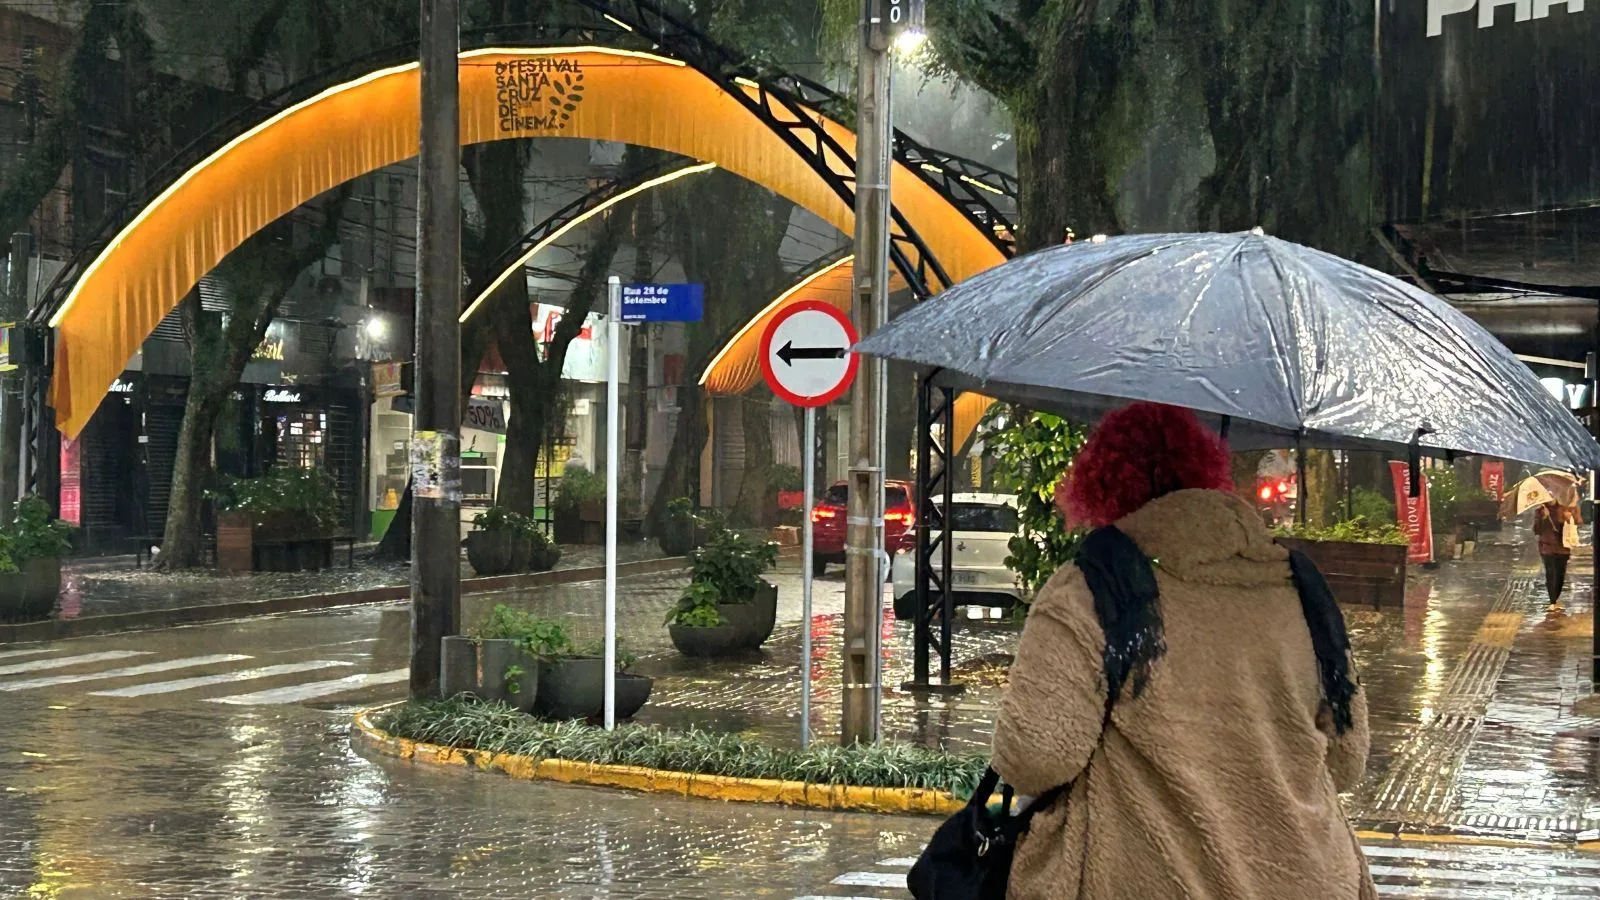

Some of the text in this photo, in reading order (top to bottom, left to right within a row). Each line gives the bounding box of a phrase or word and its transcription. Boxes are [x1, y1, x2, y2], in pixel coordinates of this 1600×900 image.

[509, 58, 582, 74] FESTIVAL
[496, 72, 550, 89] SANTA
[497, 88, 541, 103] CRUZ
[499, 104, 518, 118] DE
[501, 116, 558, 131] CINEMA
[623, 286, 641, 295] Rua
[657, 287, 669, 295] de
[624, 296, 667, 304] Setembro
[467, 405, 500, 428] 50%
